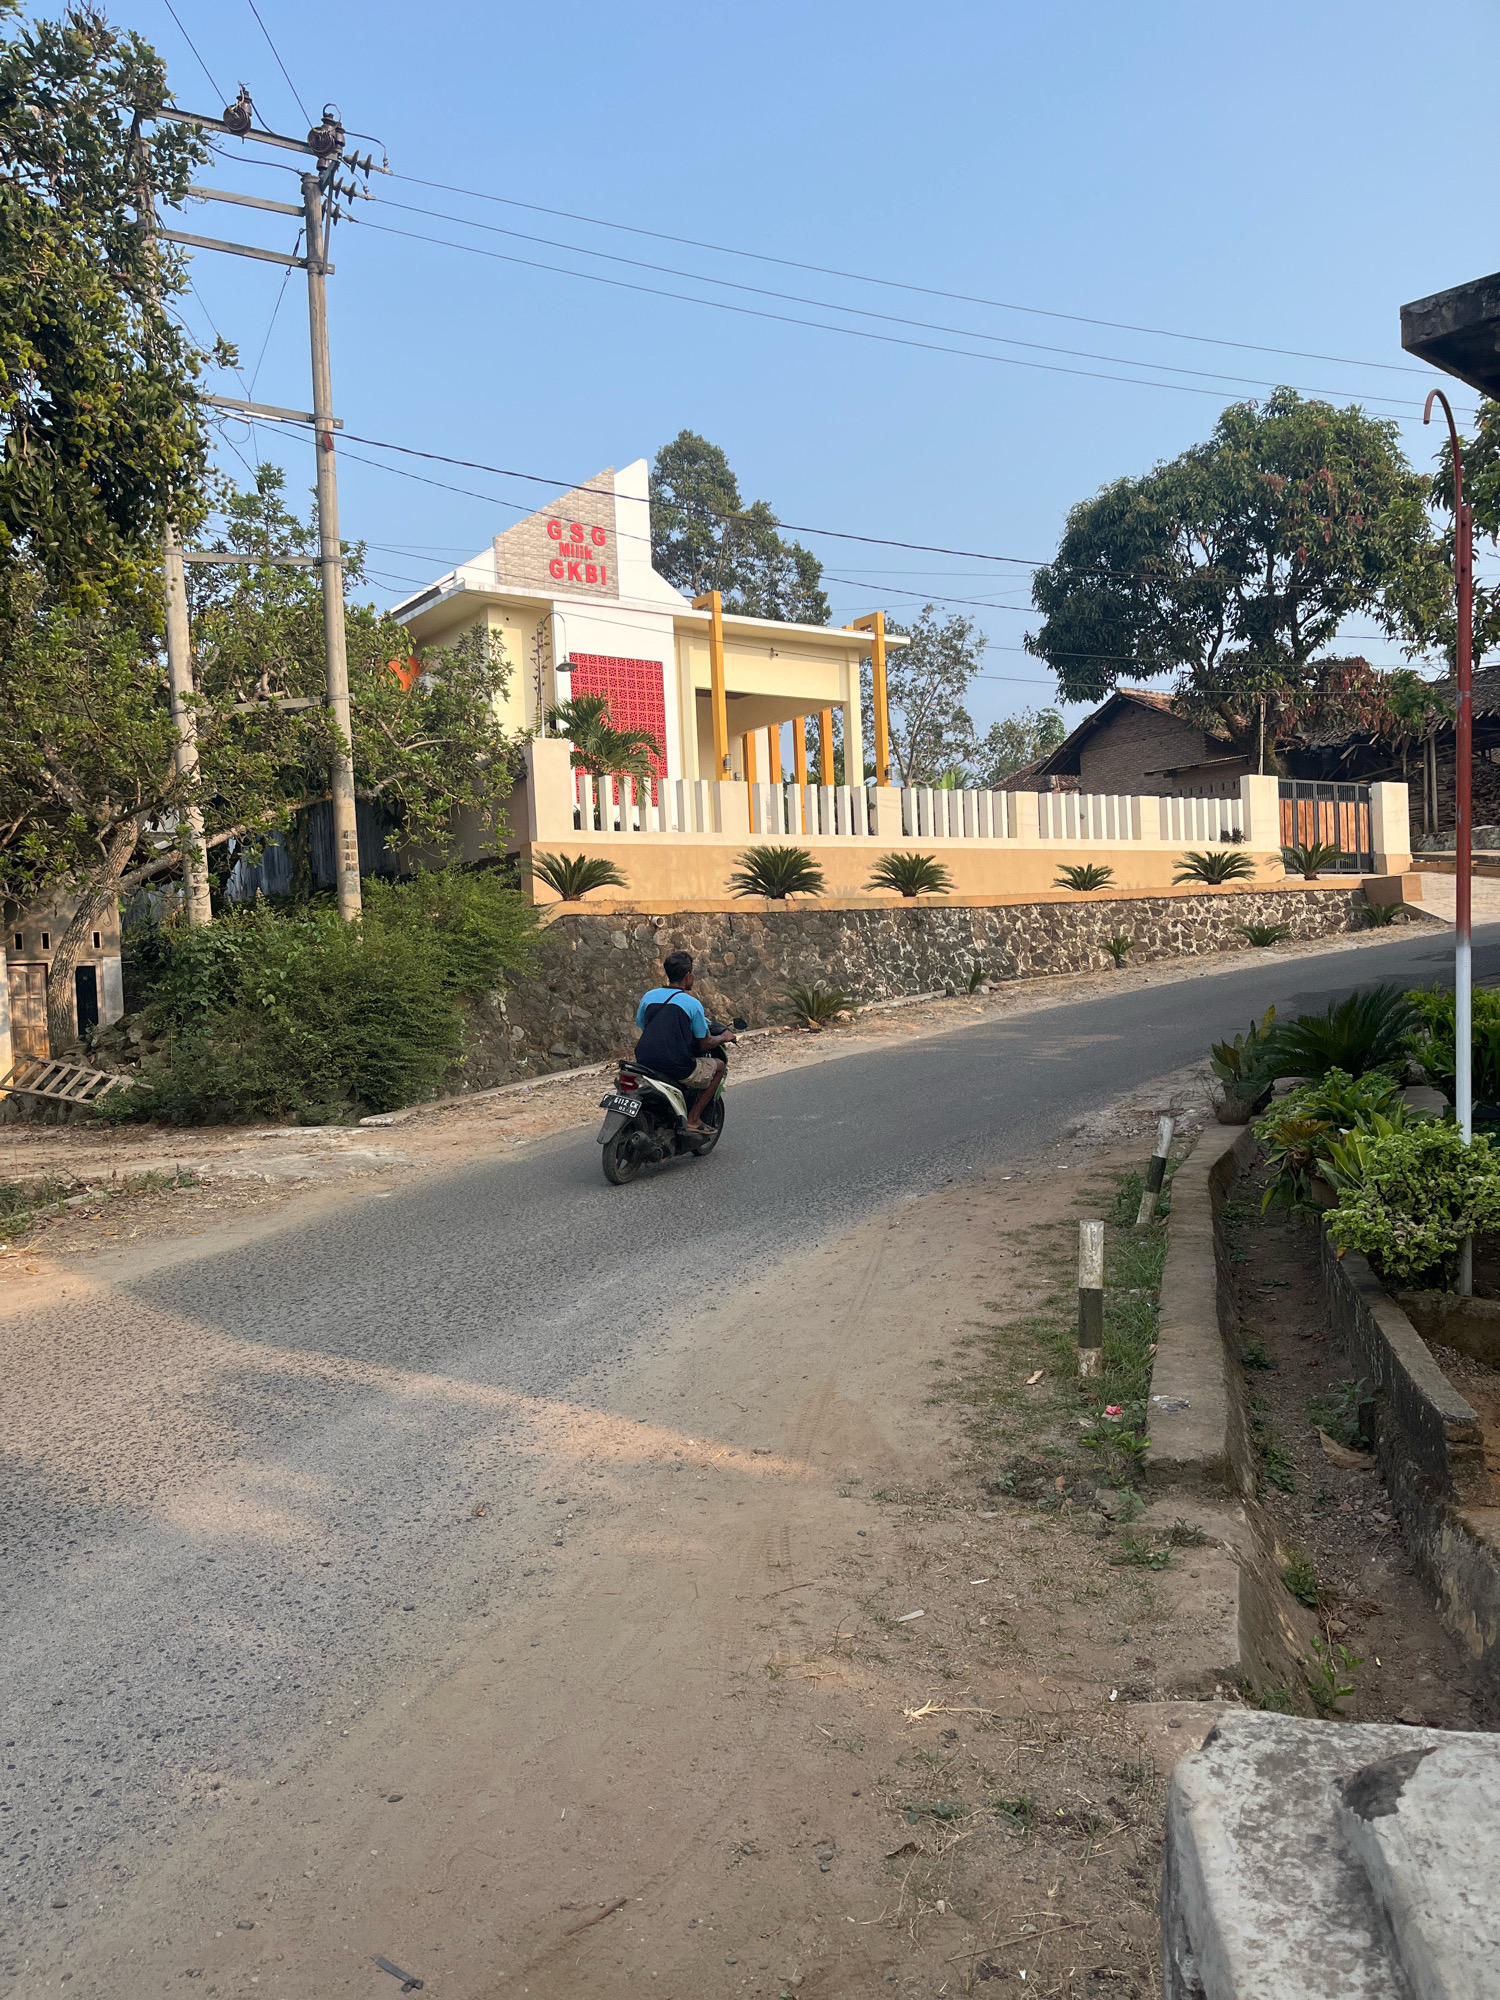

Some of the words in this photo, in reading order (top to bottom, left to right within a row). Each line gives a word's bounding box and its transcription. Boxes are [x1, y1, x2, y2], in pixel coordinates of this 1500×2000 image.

[559, 542, 593, 560] Milik
[549, 558, 607, 585] GKBI
[614, 1097, 629, 1106] 6112
